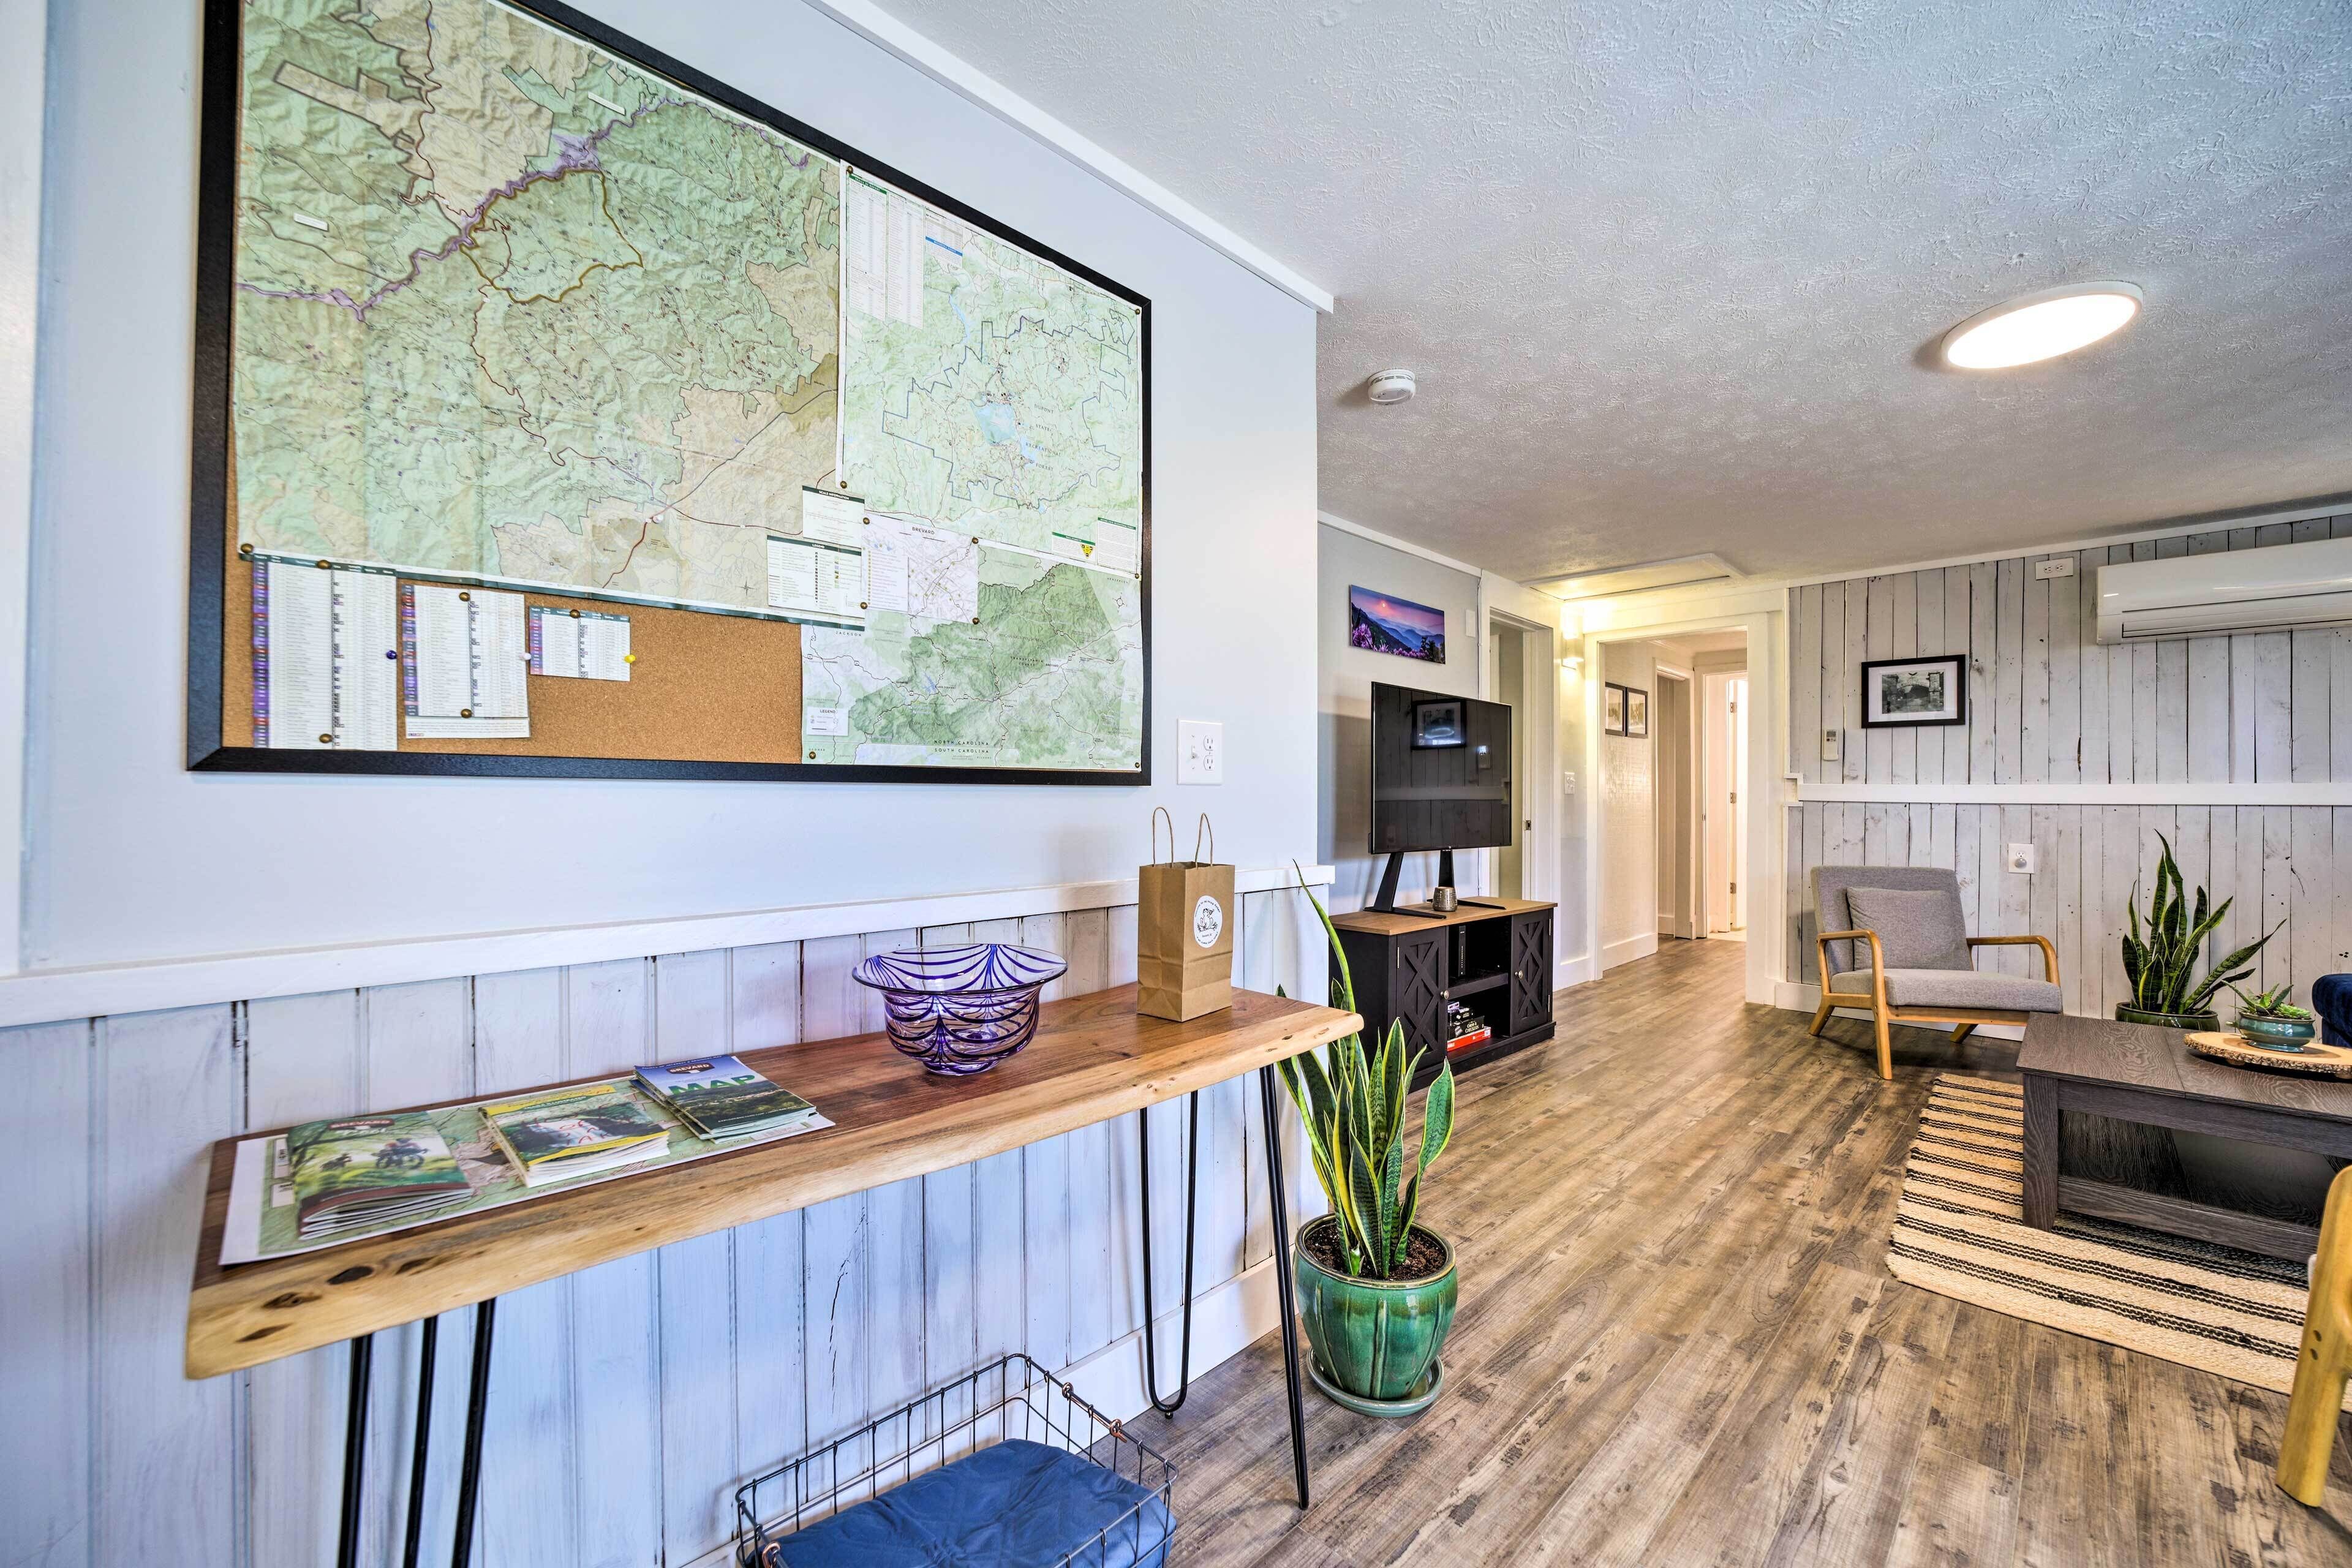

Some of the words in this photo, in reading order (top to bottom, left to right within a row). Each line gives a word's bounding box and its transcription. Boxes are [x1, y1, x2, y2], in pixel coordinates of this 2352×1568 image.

[1034, 404, 1054, 414] DUPONT
[1025, 442, 1061, 456] RECREATIONAL
[1036, 462, 1054, 471] FOREST
[912, 527, 935, 535] BREVARD
[670, 1063, 710, 1073] BREVARD
[668, 1074, 755, 1095] MAP
